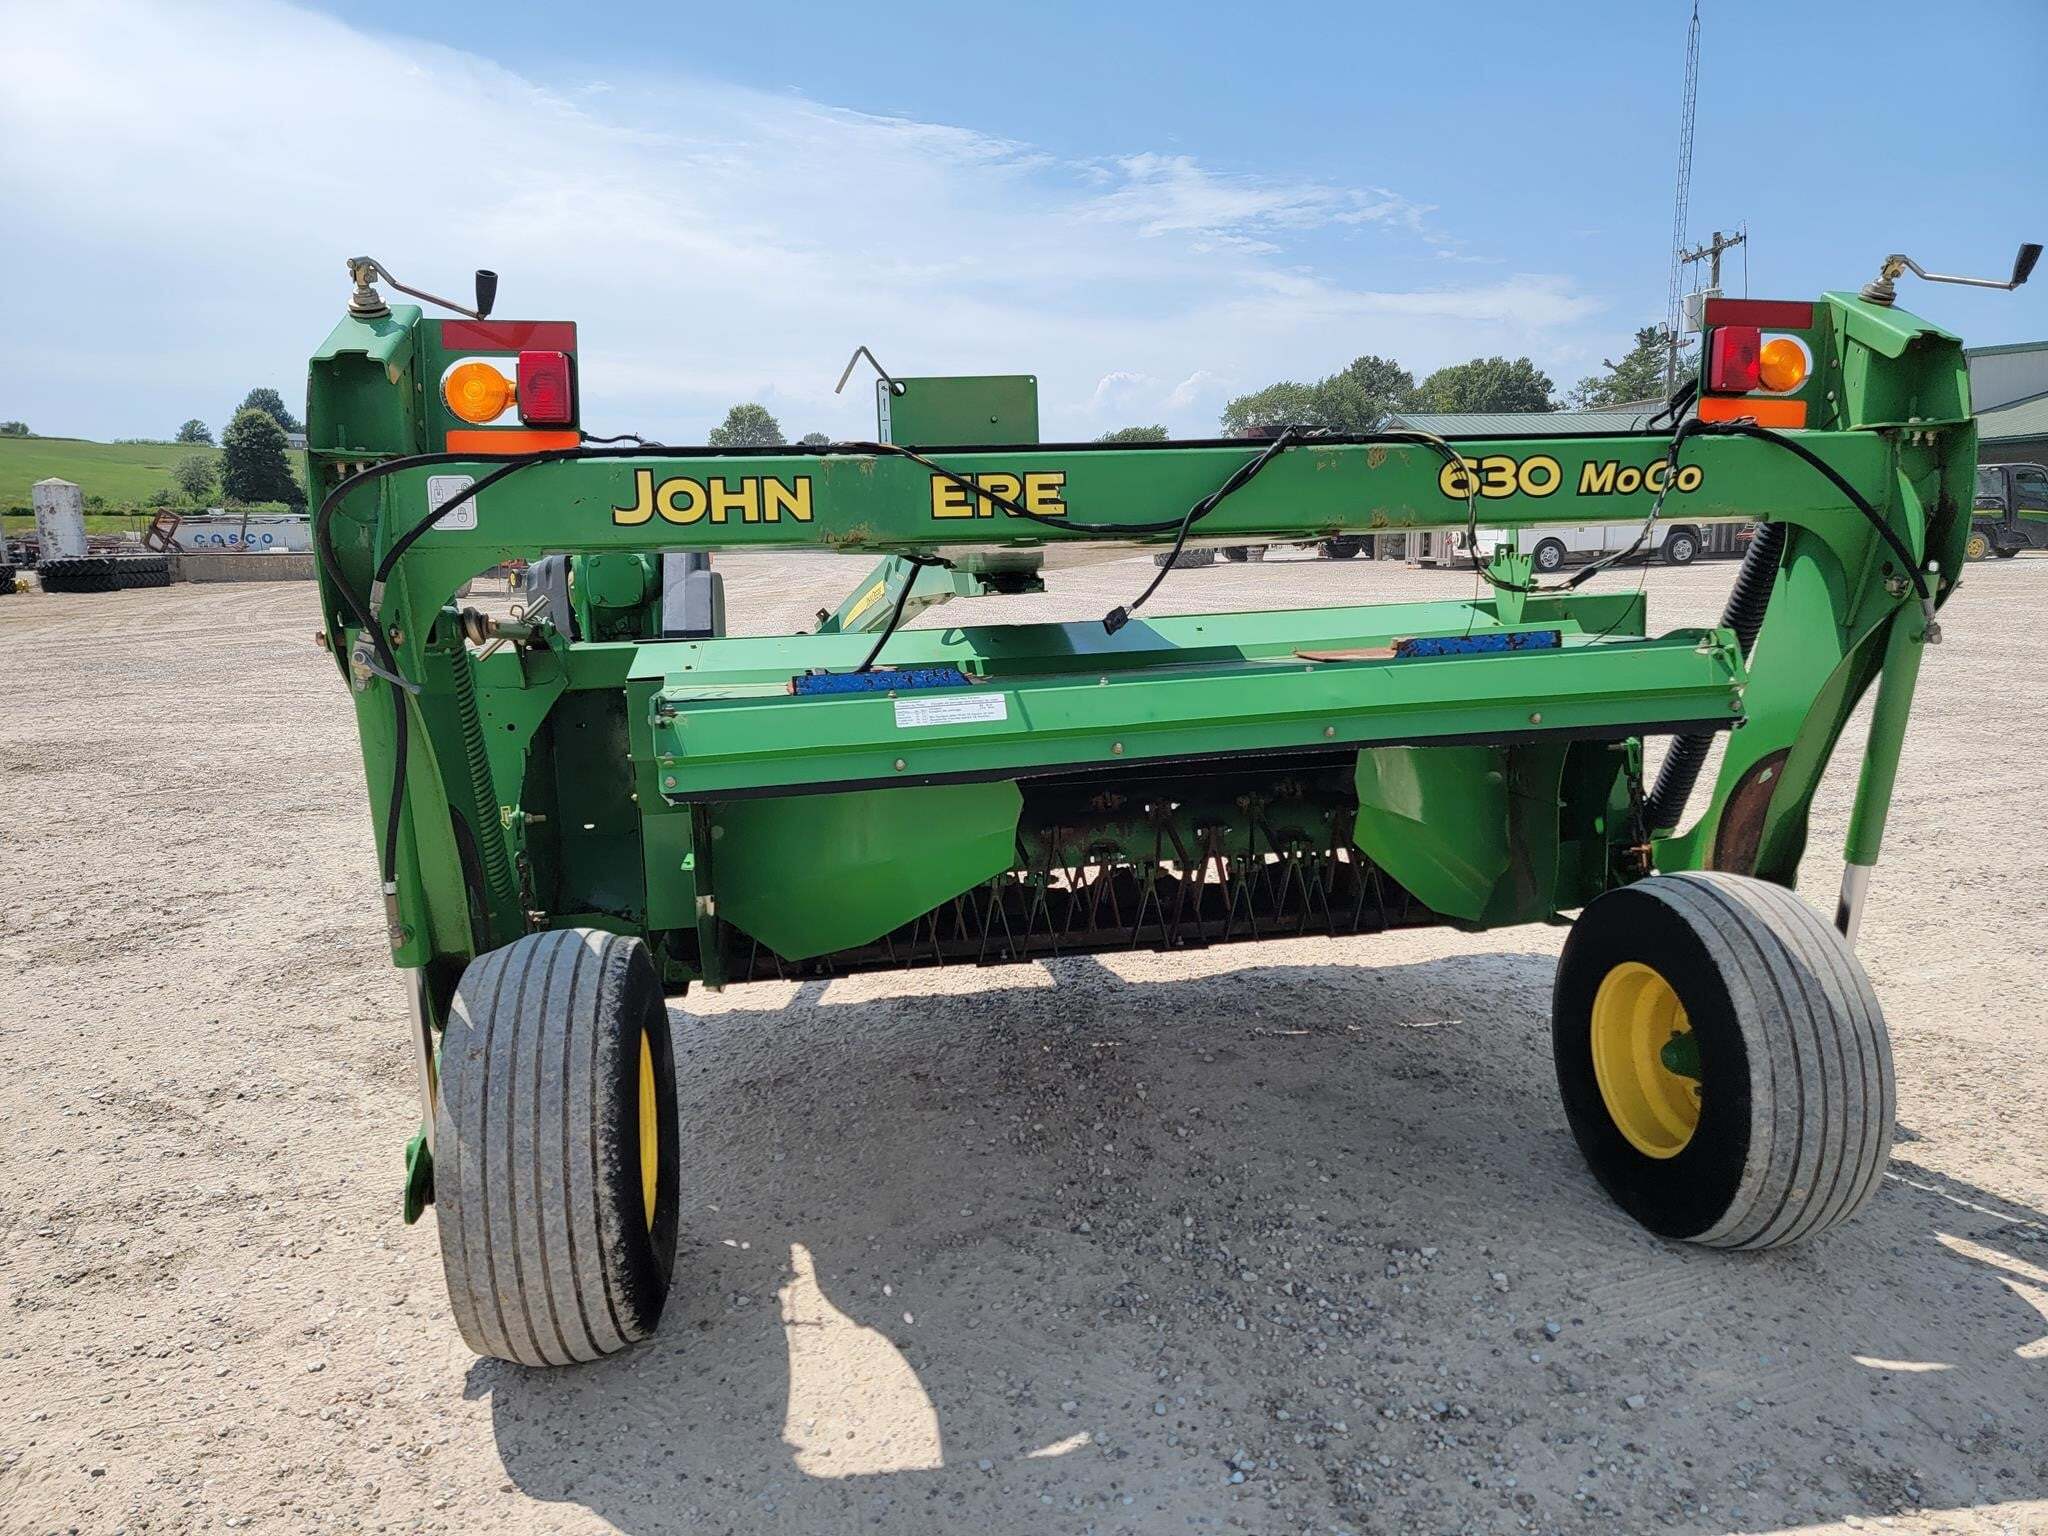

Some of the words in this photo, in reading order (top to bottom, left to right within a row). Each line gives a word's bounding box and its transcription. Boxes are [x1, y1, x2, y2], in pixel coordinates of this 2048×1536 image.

[612, 468, 813, 525] JOHN
[1439, 455, 1562, 499] 630
[1577, 458, 1703, 496] MoCo
[195, 533, 273, 545] COSCO
